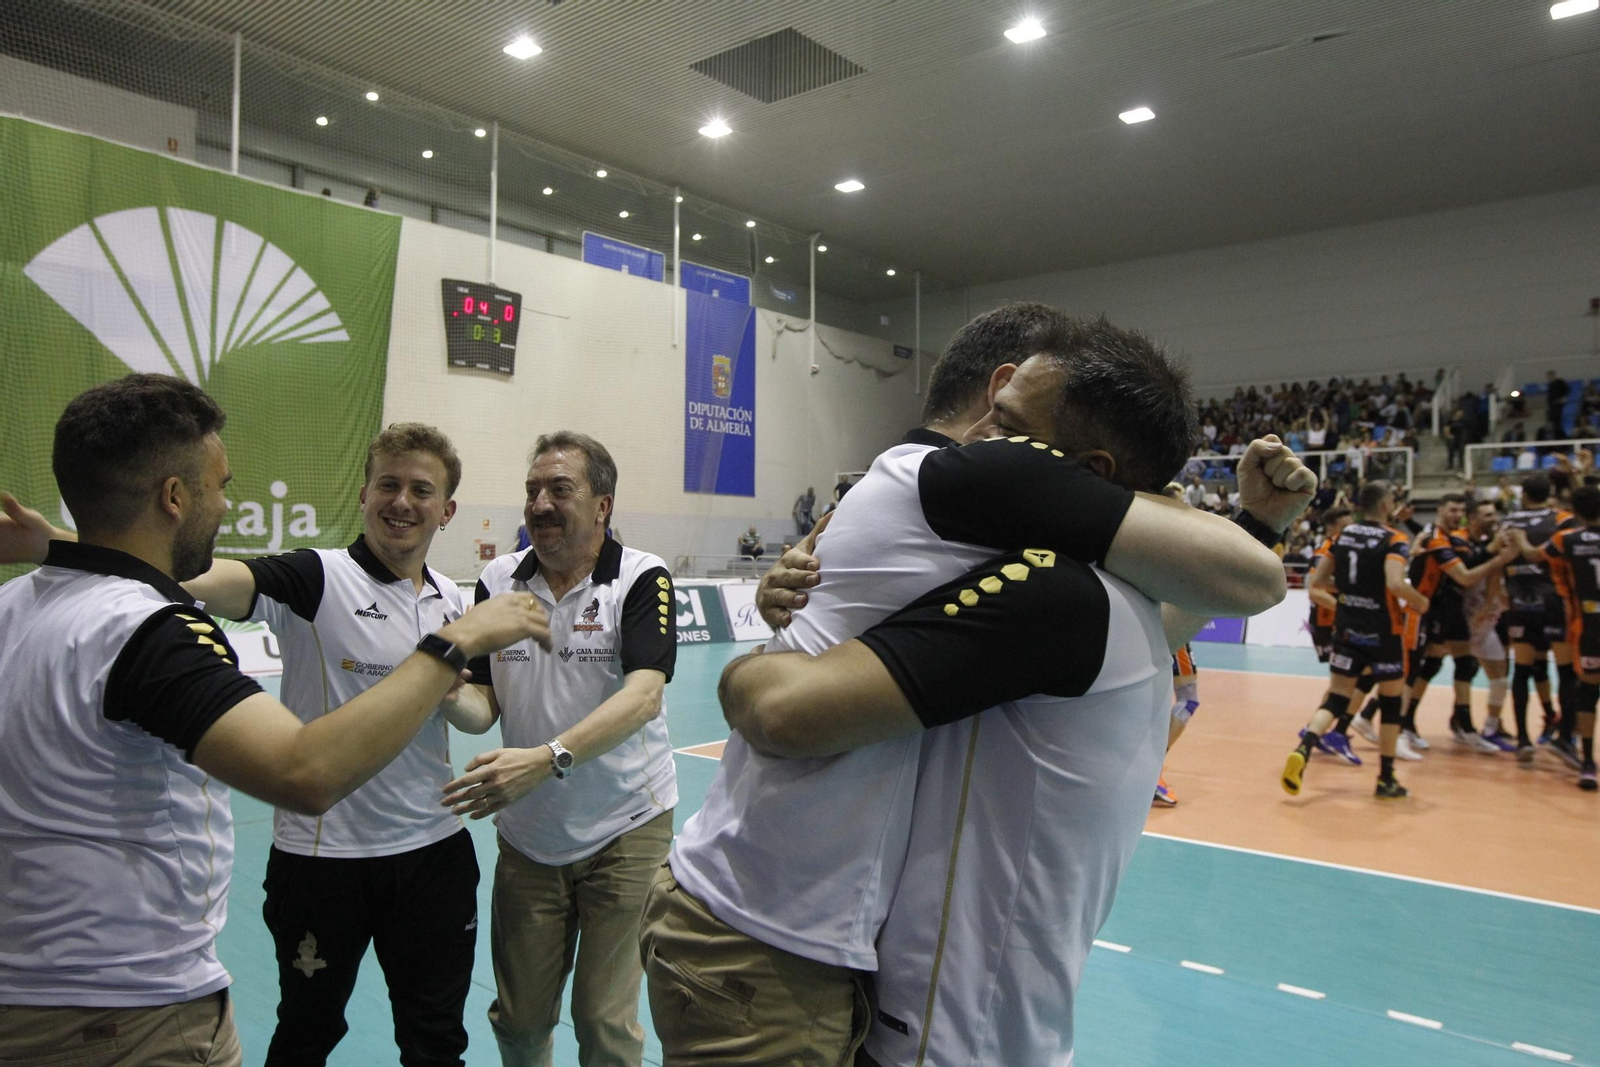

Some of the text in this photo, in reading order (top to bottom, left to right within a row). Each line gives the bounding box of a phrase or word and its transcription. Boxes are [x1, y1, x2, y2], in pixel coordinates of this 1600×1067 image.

[463, 297, 474, 315] 0
[479, 301, 489, 315] 4
[503, 304, 514, 322] 0
[688, 401, 753, 422] DIPUTACIÓN
[690, 416, 752, 436] DE ALMERÍA
[354, 608, 389, 620] MERCURY
[355, 661, 394, 671] GOBIERNO
